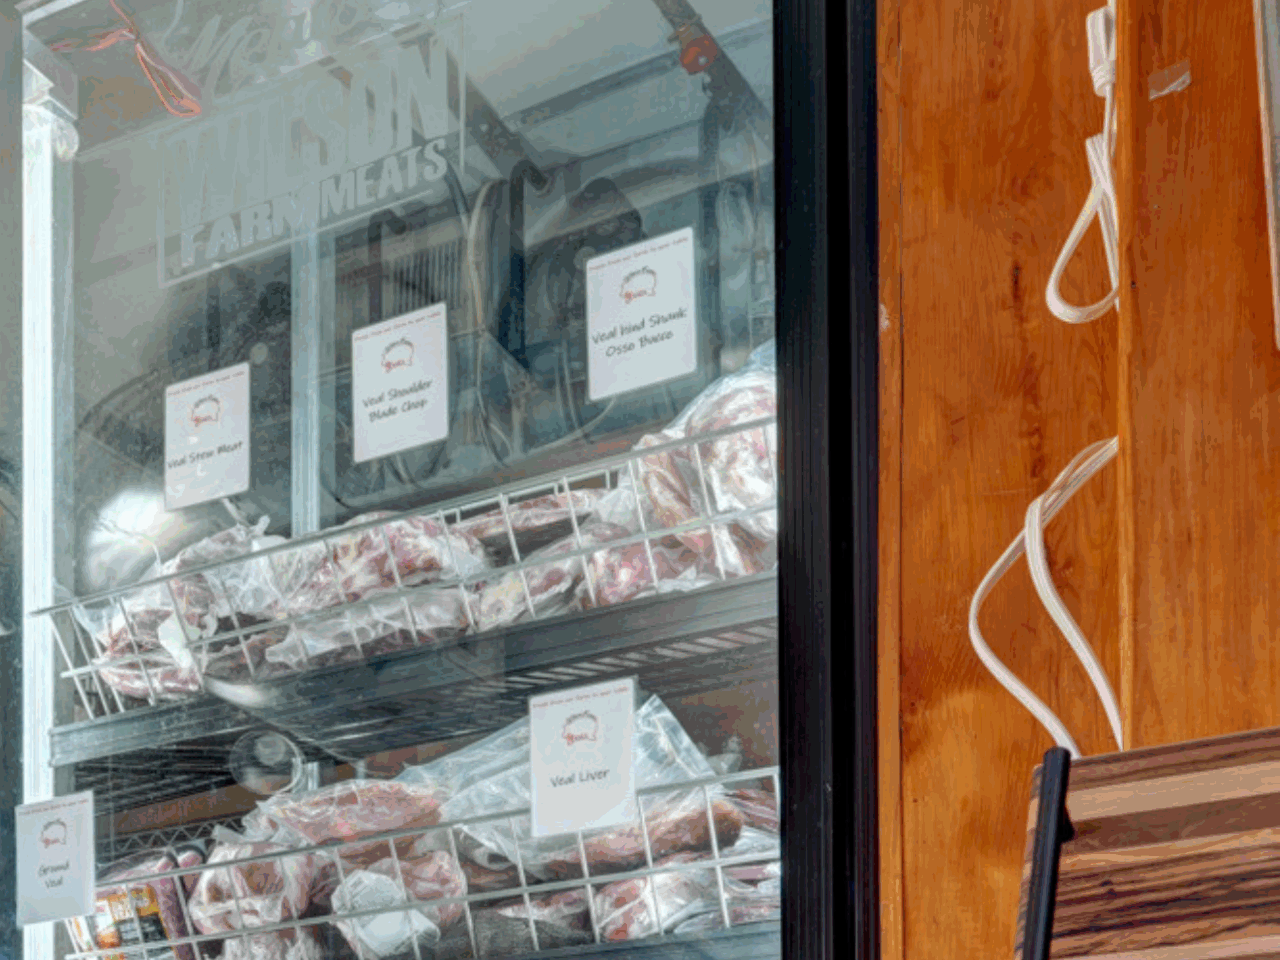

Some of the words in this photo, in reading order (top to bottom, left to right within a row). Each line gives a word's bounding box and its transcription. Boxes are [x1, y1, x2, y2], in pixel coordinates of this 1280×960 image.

[592, 326, 617, 344] Veal
[648, 307, 687, 328] Shank
[605, 342, 635, 357] Osso
[362, 392, 385, 408] Veal
[387, 379, 433, 401] Shoulder
[368, 405, 398, 423] Blade
[401, 399, 428, 413] Chop
[189, 450, 214, 463] Stew
[550, 772, 575, 787] Veal
[579, 768, 610, 783] Liver
[38, 860, 70, 878] Ground
[45, 876, 63, 889] Veal
